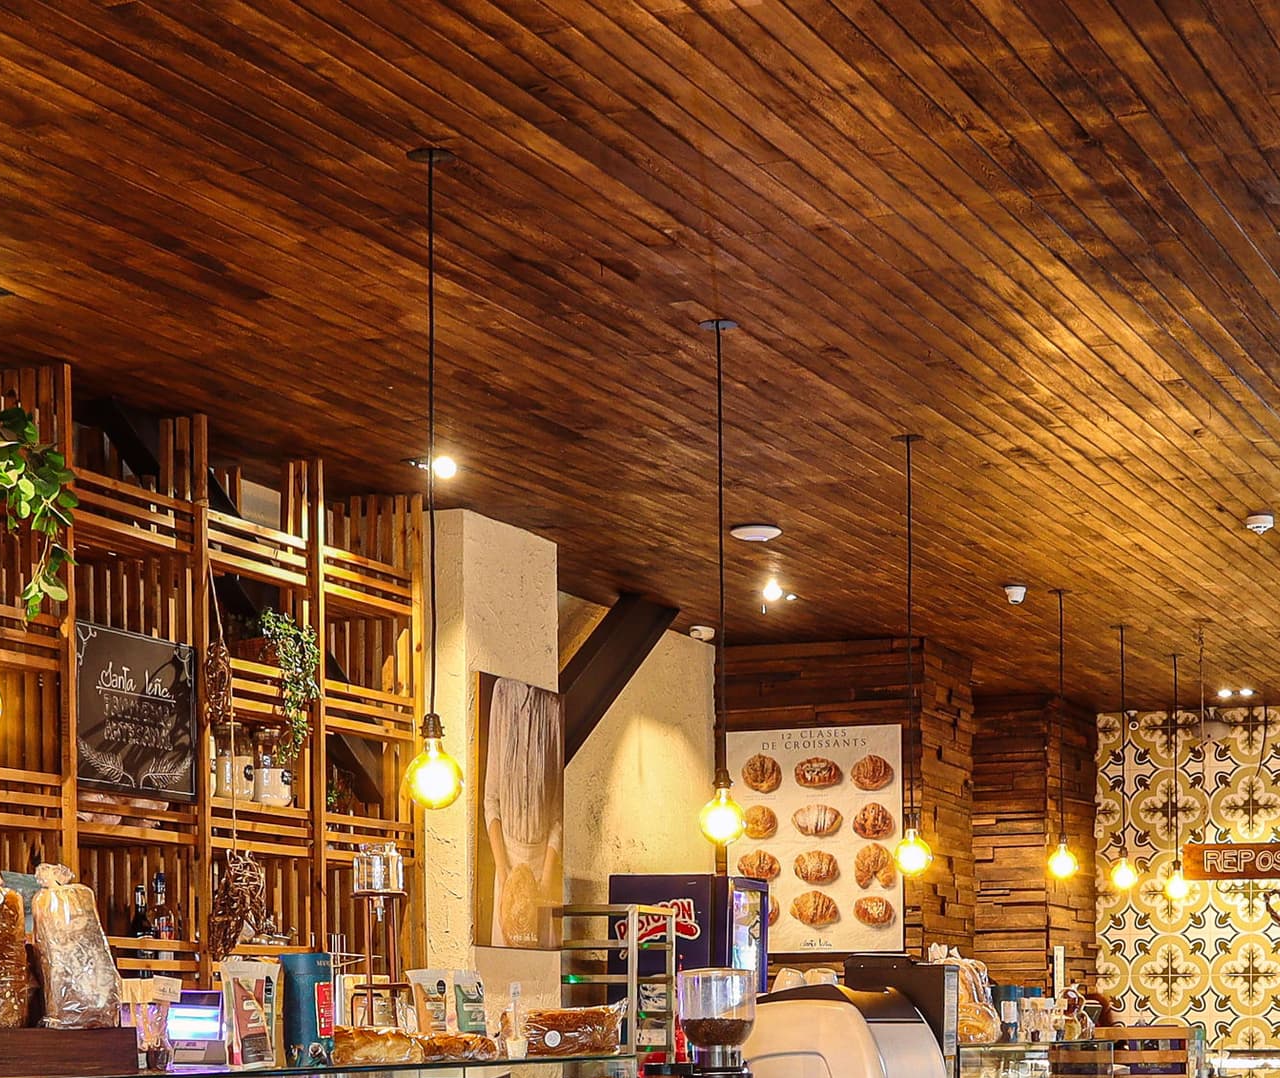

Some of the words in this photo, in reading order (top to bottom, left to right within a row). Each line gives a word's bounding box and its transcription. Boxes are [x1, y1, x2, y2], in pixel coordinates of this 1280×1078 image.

[101, 661, 136, 694] Santa
[781, 732, 793, 741] 12
[800, 728, 848, 739] CLASES
[761, 741, 778, 751] DE
[784, 737, 868, 750] CROISSANTS
